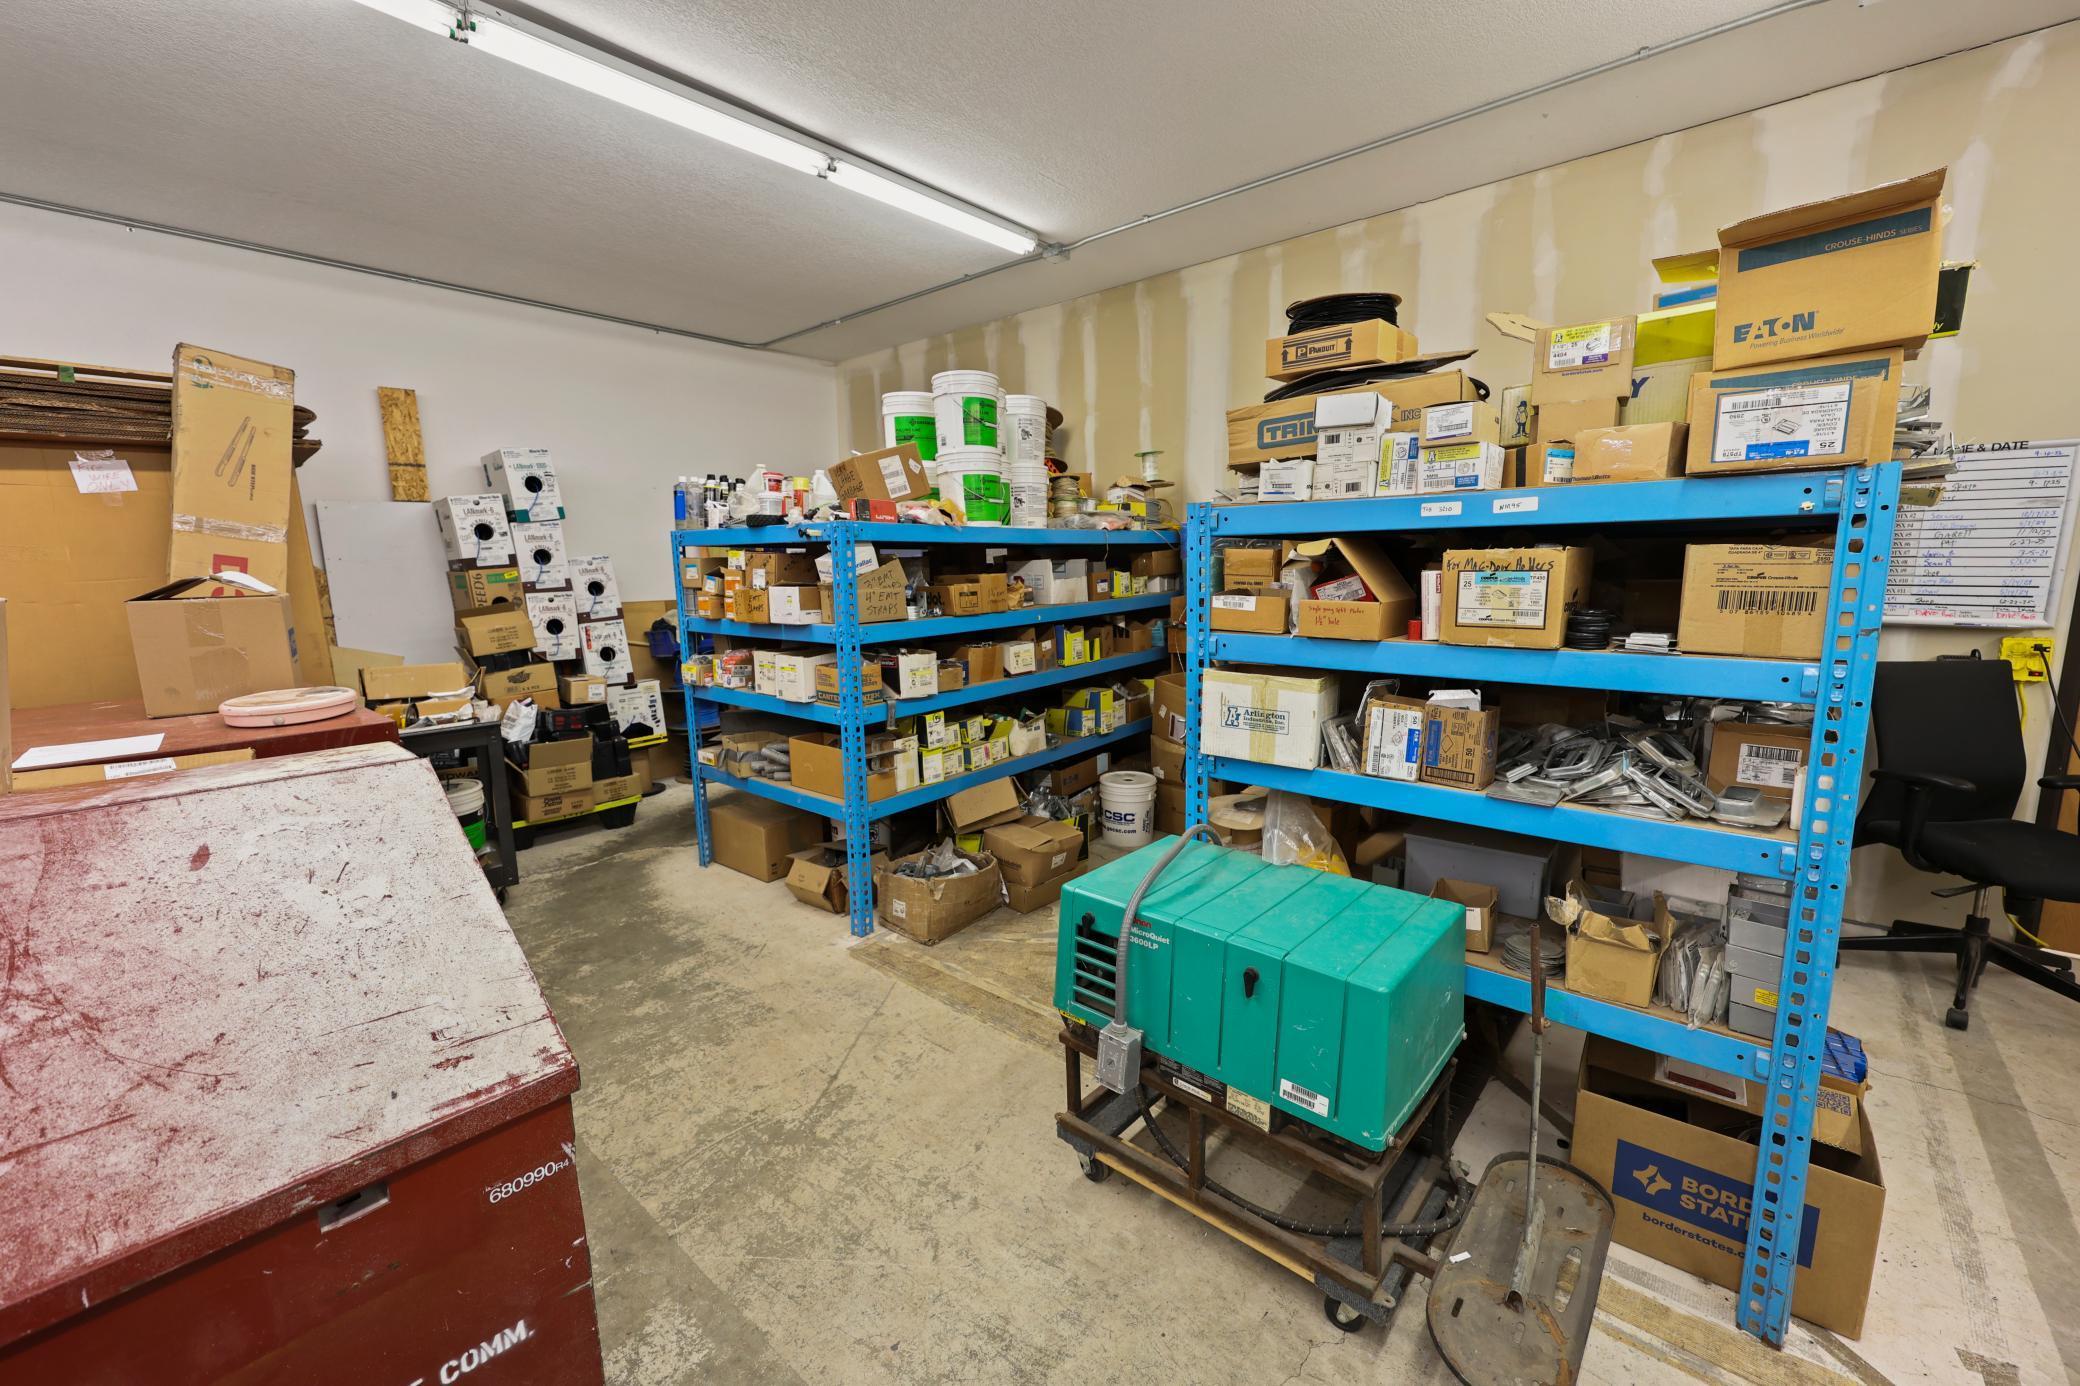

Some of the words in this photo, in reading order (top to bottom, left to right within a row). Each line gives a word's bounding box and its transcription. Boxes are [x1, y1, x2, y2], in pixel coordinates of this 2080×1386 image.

[1734, 311, 1816, 343] EATON
[1750, 339, 1778, 351] Powering
[1779, 334, 1807, 346] Business
[1808, 327, 1845, 340] Worldwide
[1309, 344, 1335, 355] PANDUIT
[1991, 441, 2029, 452] DATE
[879, 592, 900, 601] EMT
[866, 603, 898, 616] STRAPS
[1243, 709, 1286, 721] Arlington
[1129, 936, 1159, 950] 3600LP
[1131, 927, 1170, 944] MicroQuiet
[1681, 1176, 1750, 1215] BORD
[1679, 1193, 1750, 1232] STAT
[1642, 1212, 1747, 1260] borderstates.c
[440, 1319, 536, 1386] COMM.
